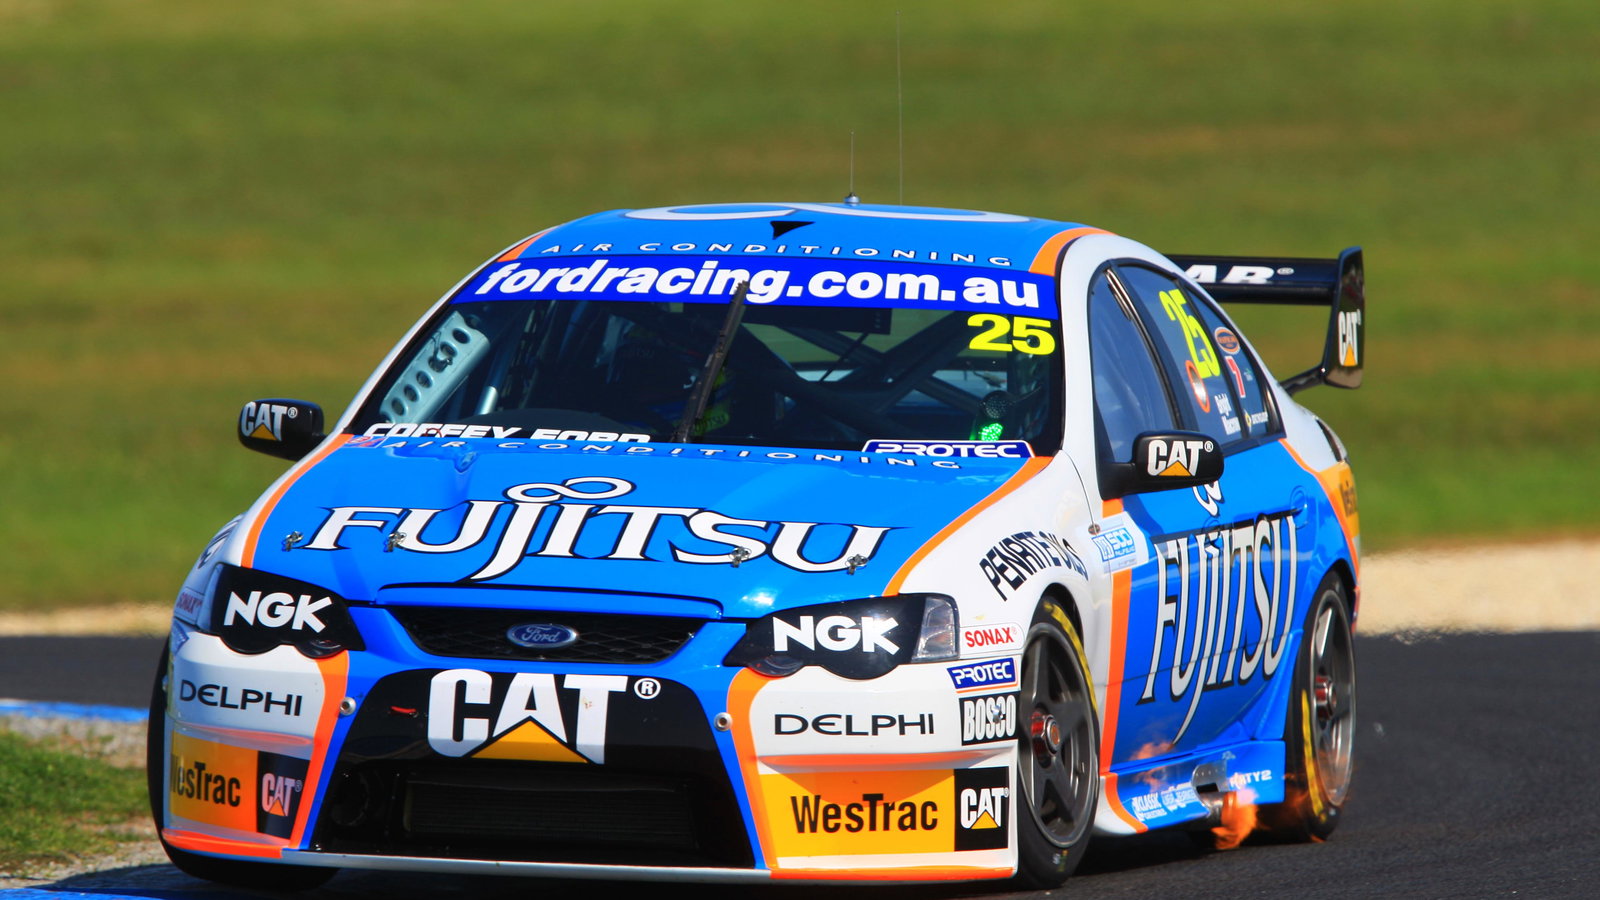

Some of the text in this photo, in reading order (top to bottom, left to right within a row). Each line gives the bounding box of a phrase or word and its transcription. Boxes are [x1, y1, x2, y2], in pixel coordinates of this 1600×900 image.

[540, 242, 1013, 267] AIR CONDITIONING
[475, 259, 1040, 309] fordracing.com.au
[966, 313, 1056, 356] 25
[1158, 289, 1221, 379] 25
[1338, 310, 1359, 367] CAT
[241, 401, 287, 441] CAT
[363, 423, 522, 438] COFFEY
[382, 440, 467, 449] AIR
[498, 441, 961, 469] CONDITIONING
[875, 443, 1021, 458] PROTEC
[1147, 440, 1204, 477] CAT
[303, 499, 894, 582] FUJITSU
[223, 591, 332, 634] NGK
[1137, 514, 1299, 746] FUJITSU
[520, 626, 561, 643] Ford
[772, 615, 900, 656] NGK
[964, 626, 1015, 648] SONAX
[951, 661, 1013, 685] PROTEC
[179, 679, 303, 716] DELPHI
[427, 668, 629, 765] CAT
[774, 713, 935, 736] DELPHI
[261, 773, 295, 817] CAT
[790, 793, 938, 834] WesTrac
[960, 787, 1006, 830] CAT
